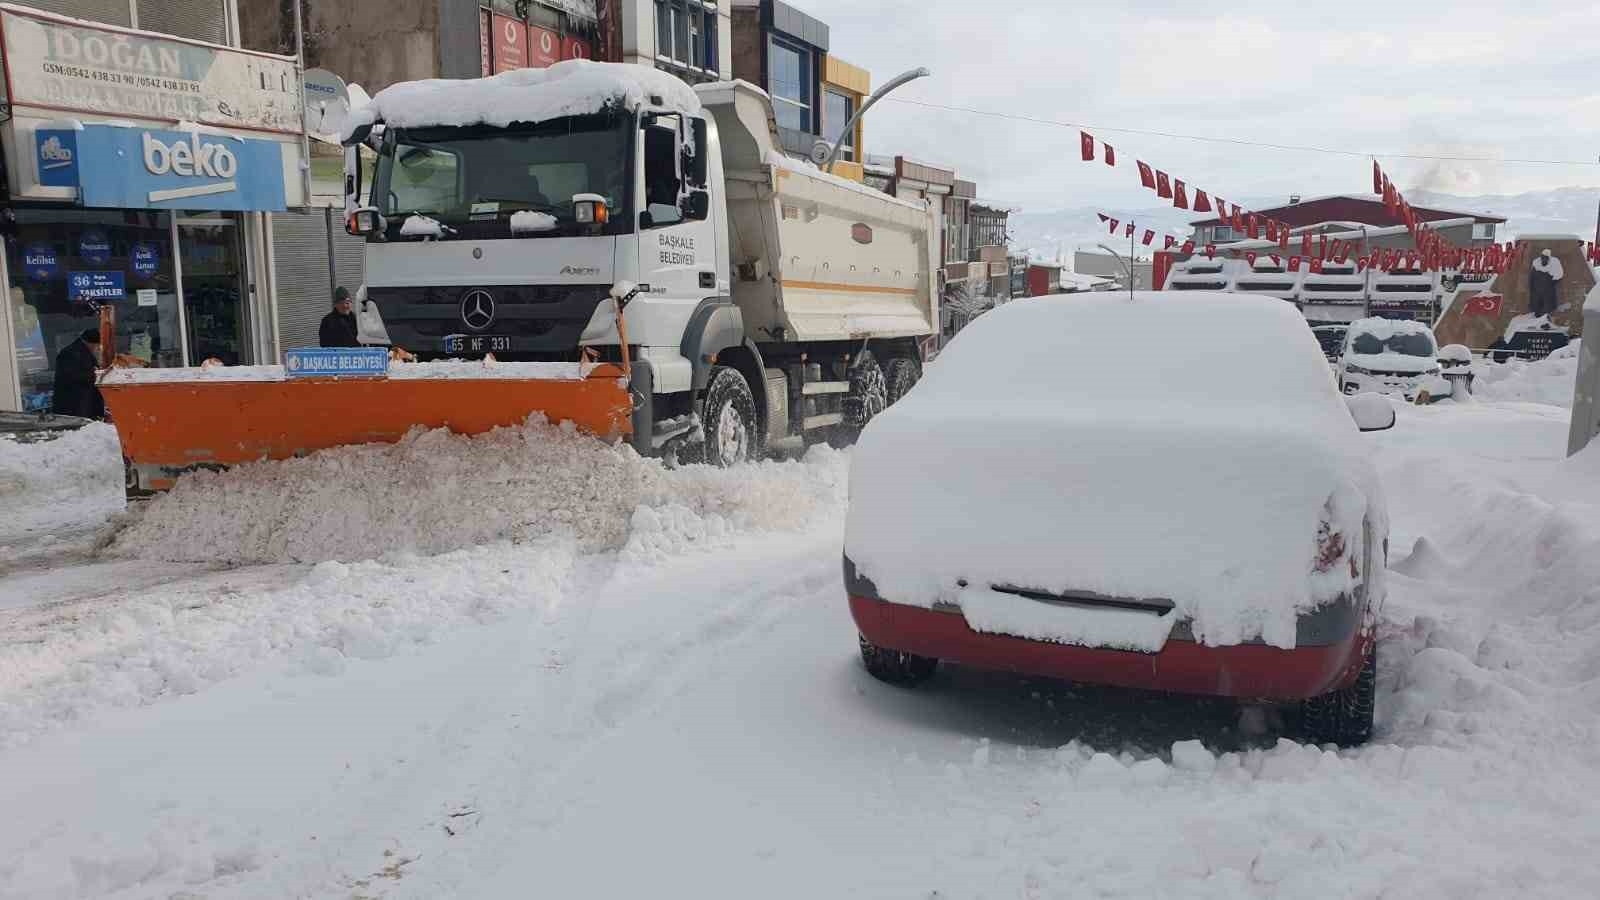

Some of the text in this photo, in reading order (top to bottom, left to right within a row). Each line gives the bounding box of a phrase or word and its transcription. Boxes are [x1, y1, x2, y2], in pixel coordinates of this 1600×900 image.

[53, 29, 180, 76] DOĞAN
[143, 131, 236, 178] beko
[659, 234, 695, 249] BAŞKALE
[74, 276, 90, 287] 36
[452, 338, 464, 351] 65
[491, 336, 510, 350] 331
[303, 354, 384, 371] BAŞKALE BELEDİYESİ
